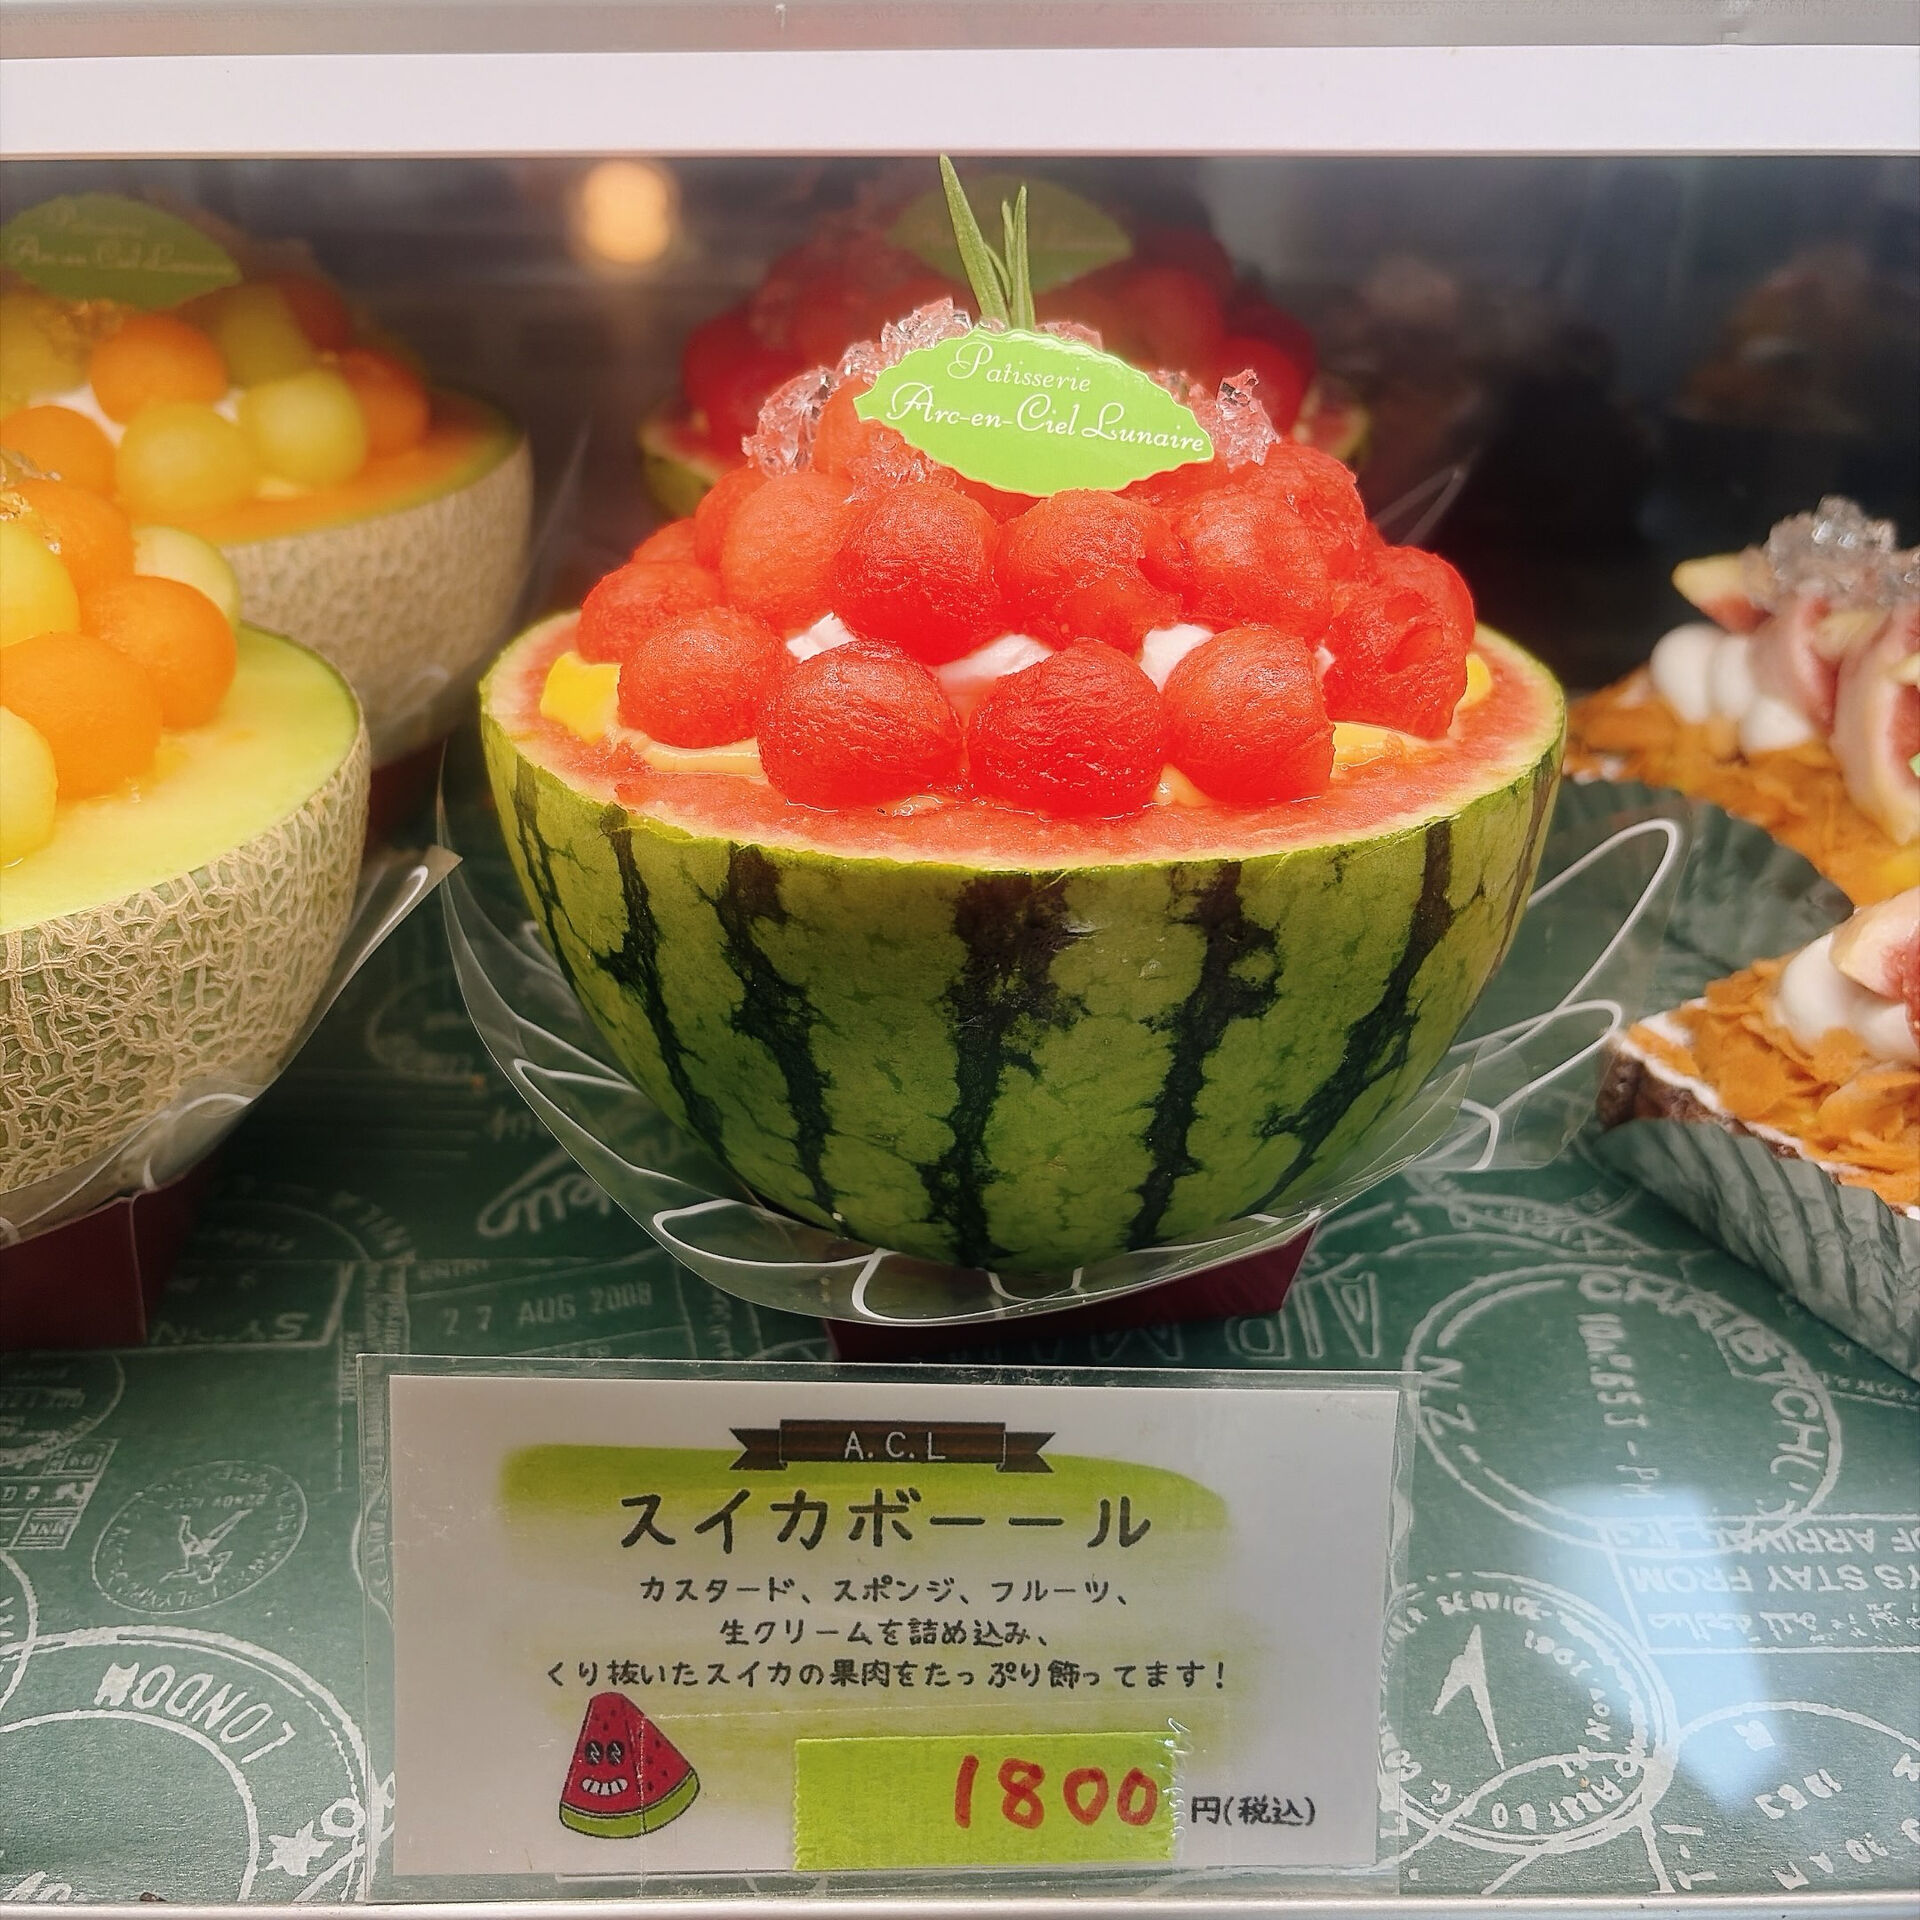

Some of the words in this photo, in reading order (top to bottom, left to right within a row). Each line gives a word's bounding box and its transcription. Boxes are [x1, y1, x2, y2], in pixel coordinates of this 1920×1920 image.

[946, 341, 1091, 393] Patisserie
[886, 381, 1080, 437] Arc-en-Ciel
[1082, 402, 1204, 453] Lunaire
[517, 1293, 577, 1328] AUG
[620, 1487, 1152, 1554] スイカボーール
[640, 1574, 1127, 1605] カスタード、スポンジ、フルーツ、
[1627, 1565, 1754, 1594] FROM
[1766, 1563, 1871, 1594] STAY
[718, 1617, 1048, 1648] 生クリームを詰め込み、
[94, 1661, 297, 1764] LONDON
[954, 1754, 1159, 1830] 1800
